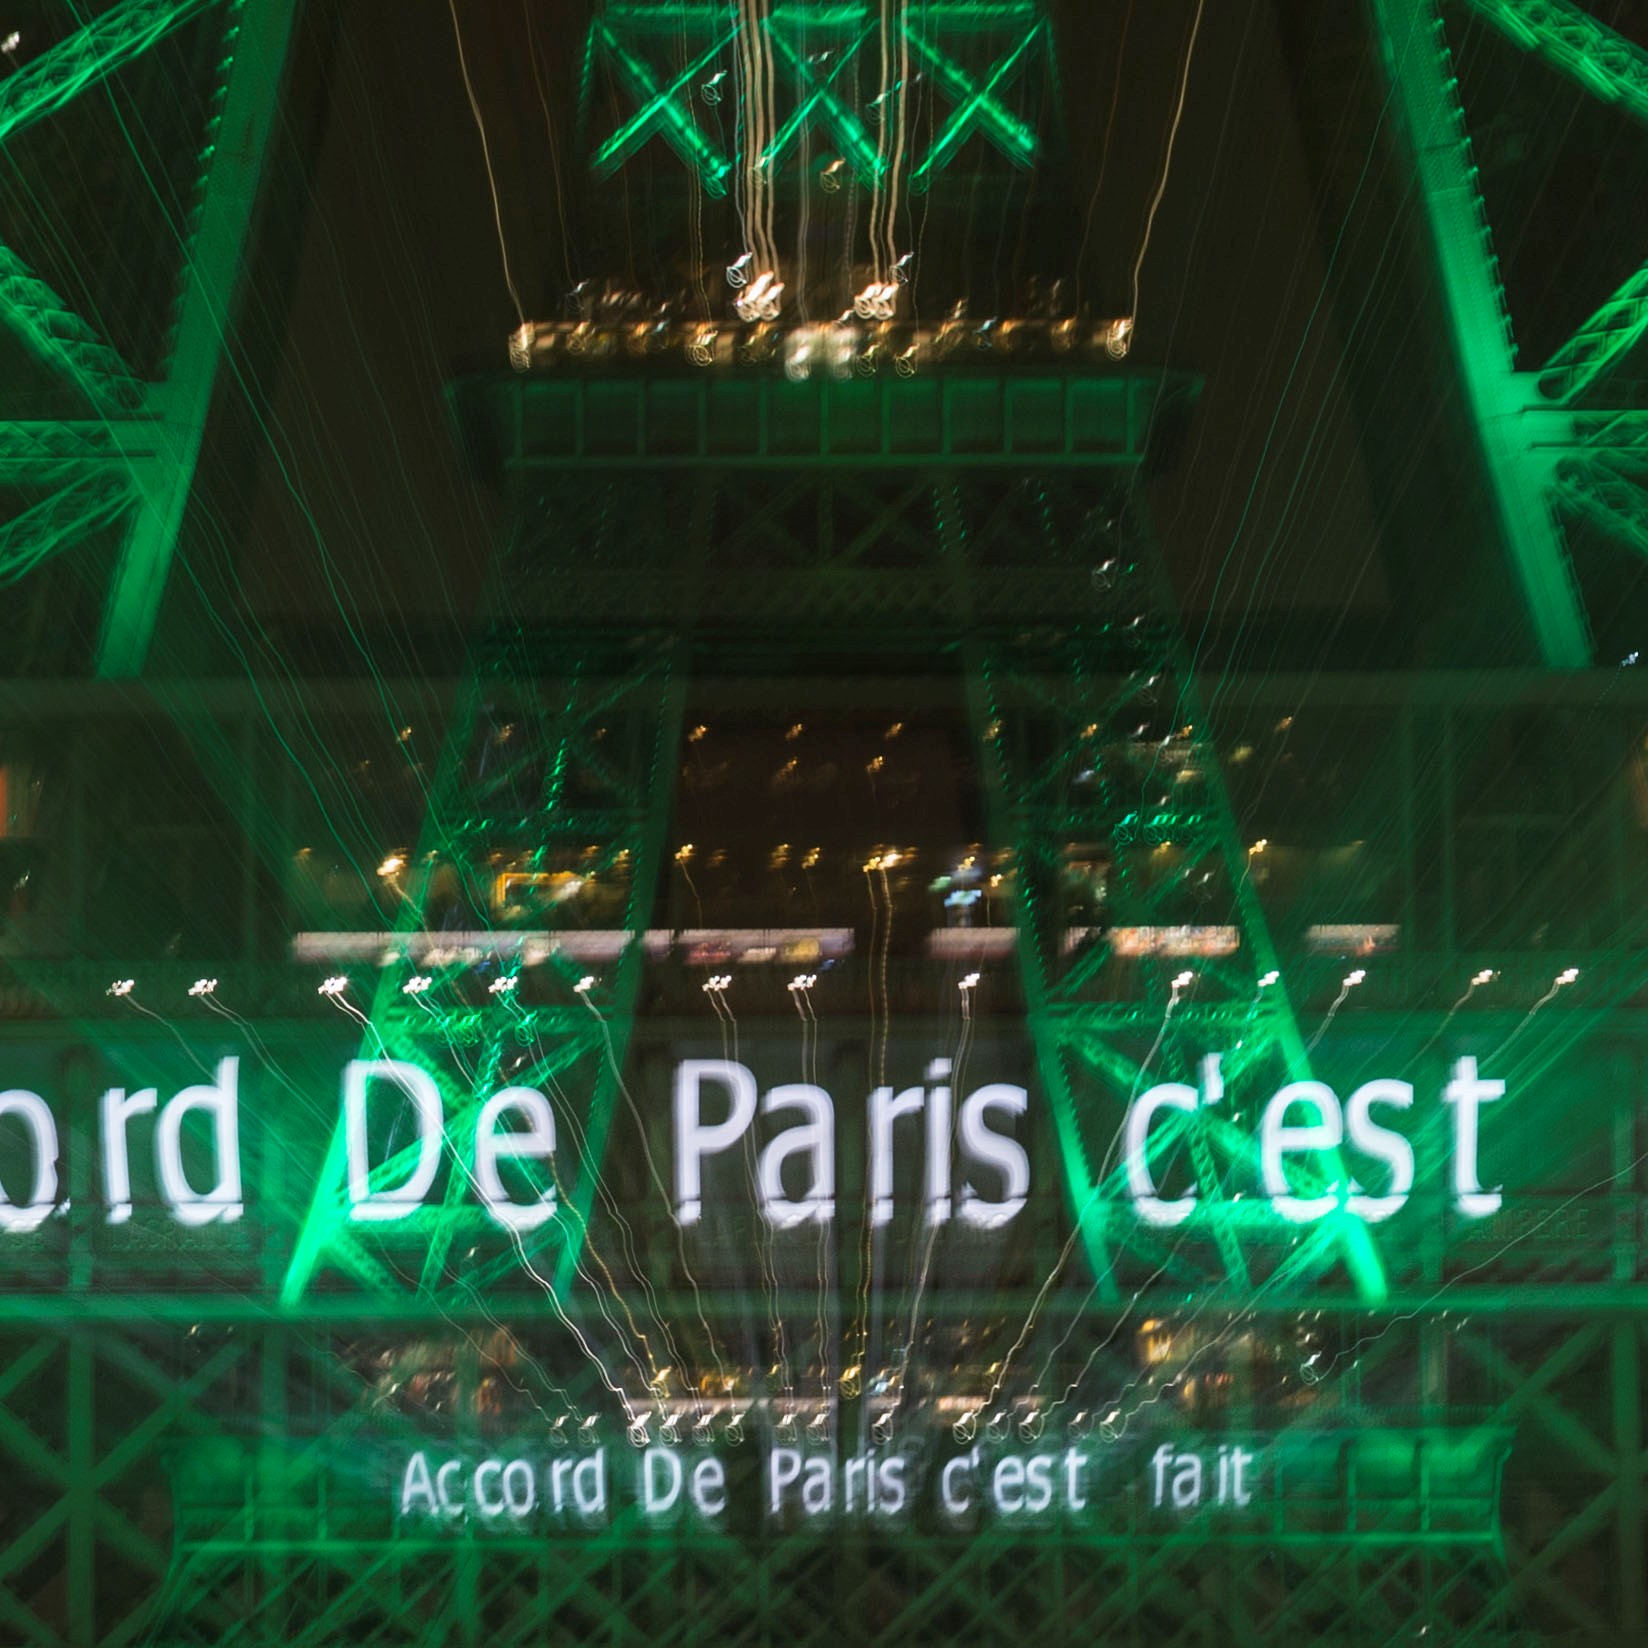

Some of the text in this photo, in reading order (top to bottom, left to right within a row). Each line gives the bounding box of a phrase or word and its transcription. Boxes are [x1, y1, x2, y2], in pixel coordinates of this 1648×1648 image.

[343, 1057, 558, 1233] De
[672, 1057, 1030, 1232] Paris
[1121, 1052, 1506, 1226] c'est
[399, 1442, 1253, 1519] Accord De Paris c'est fait
